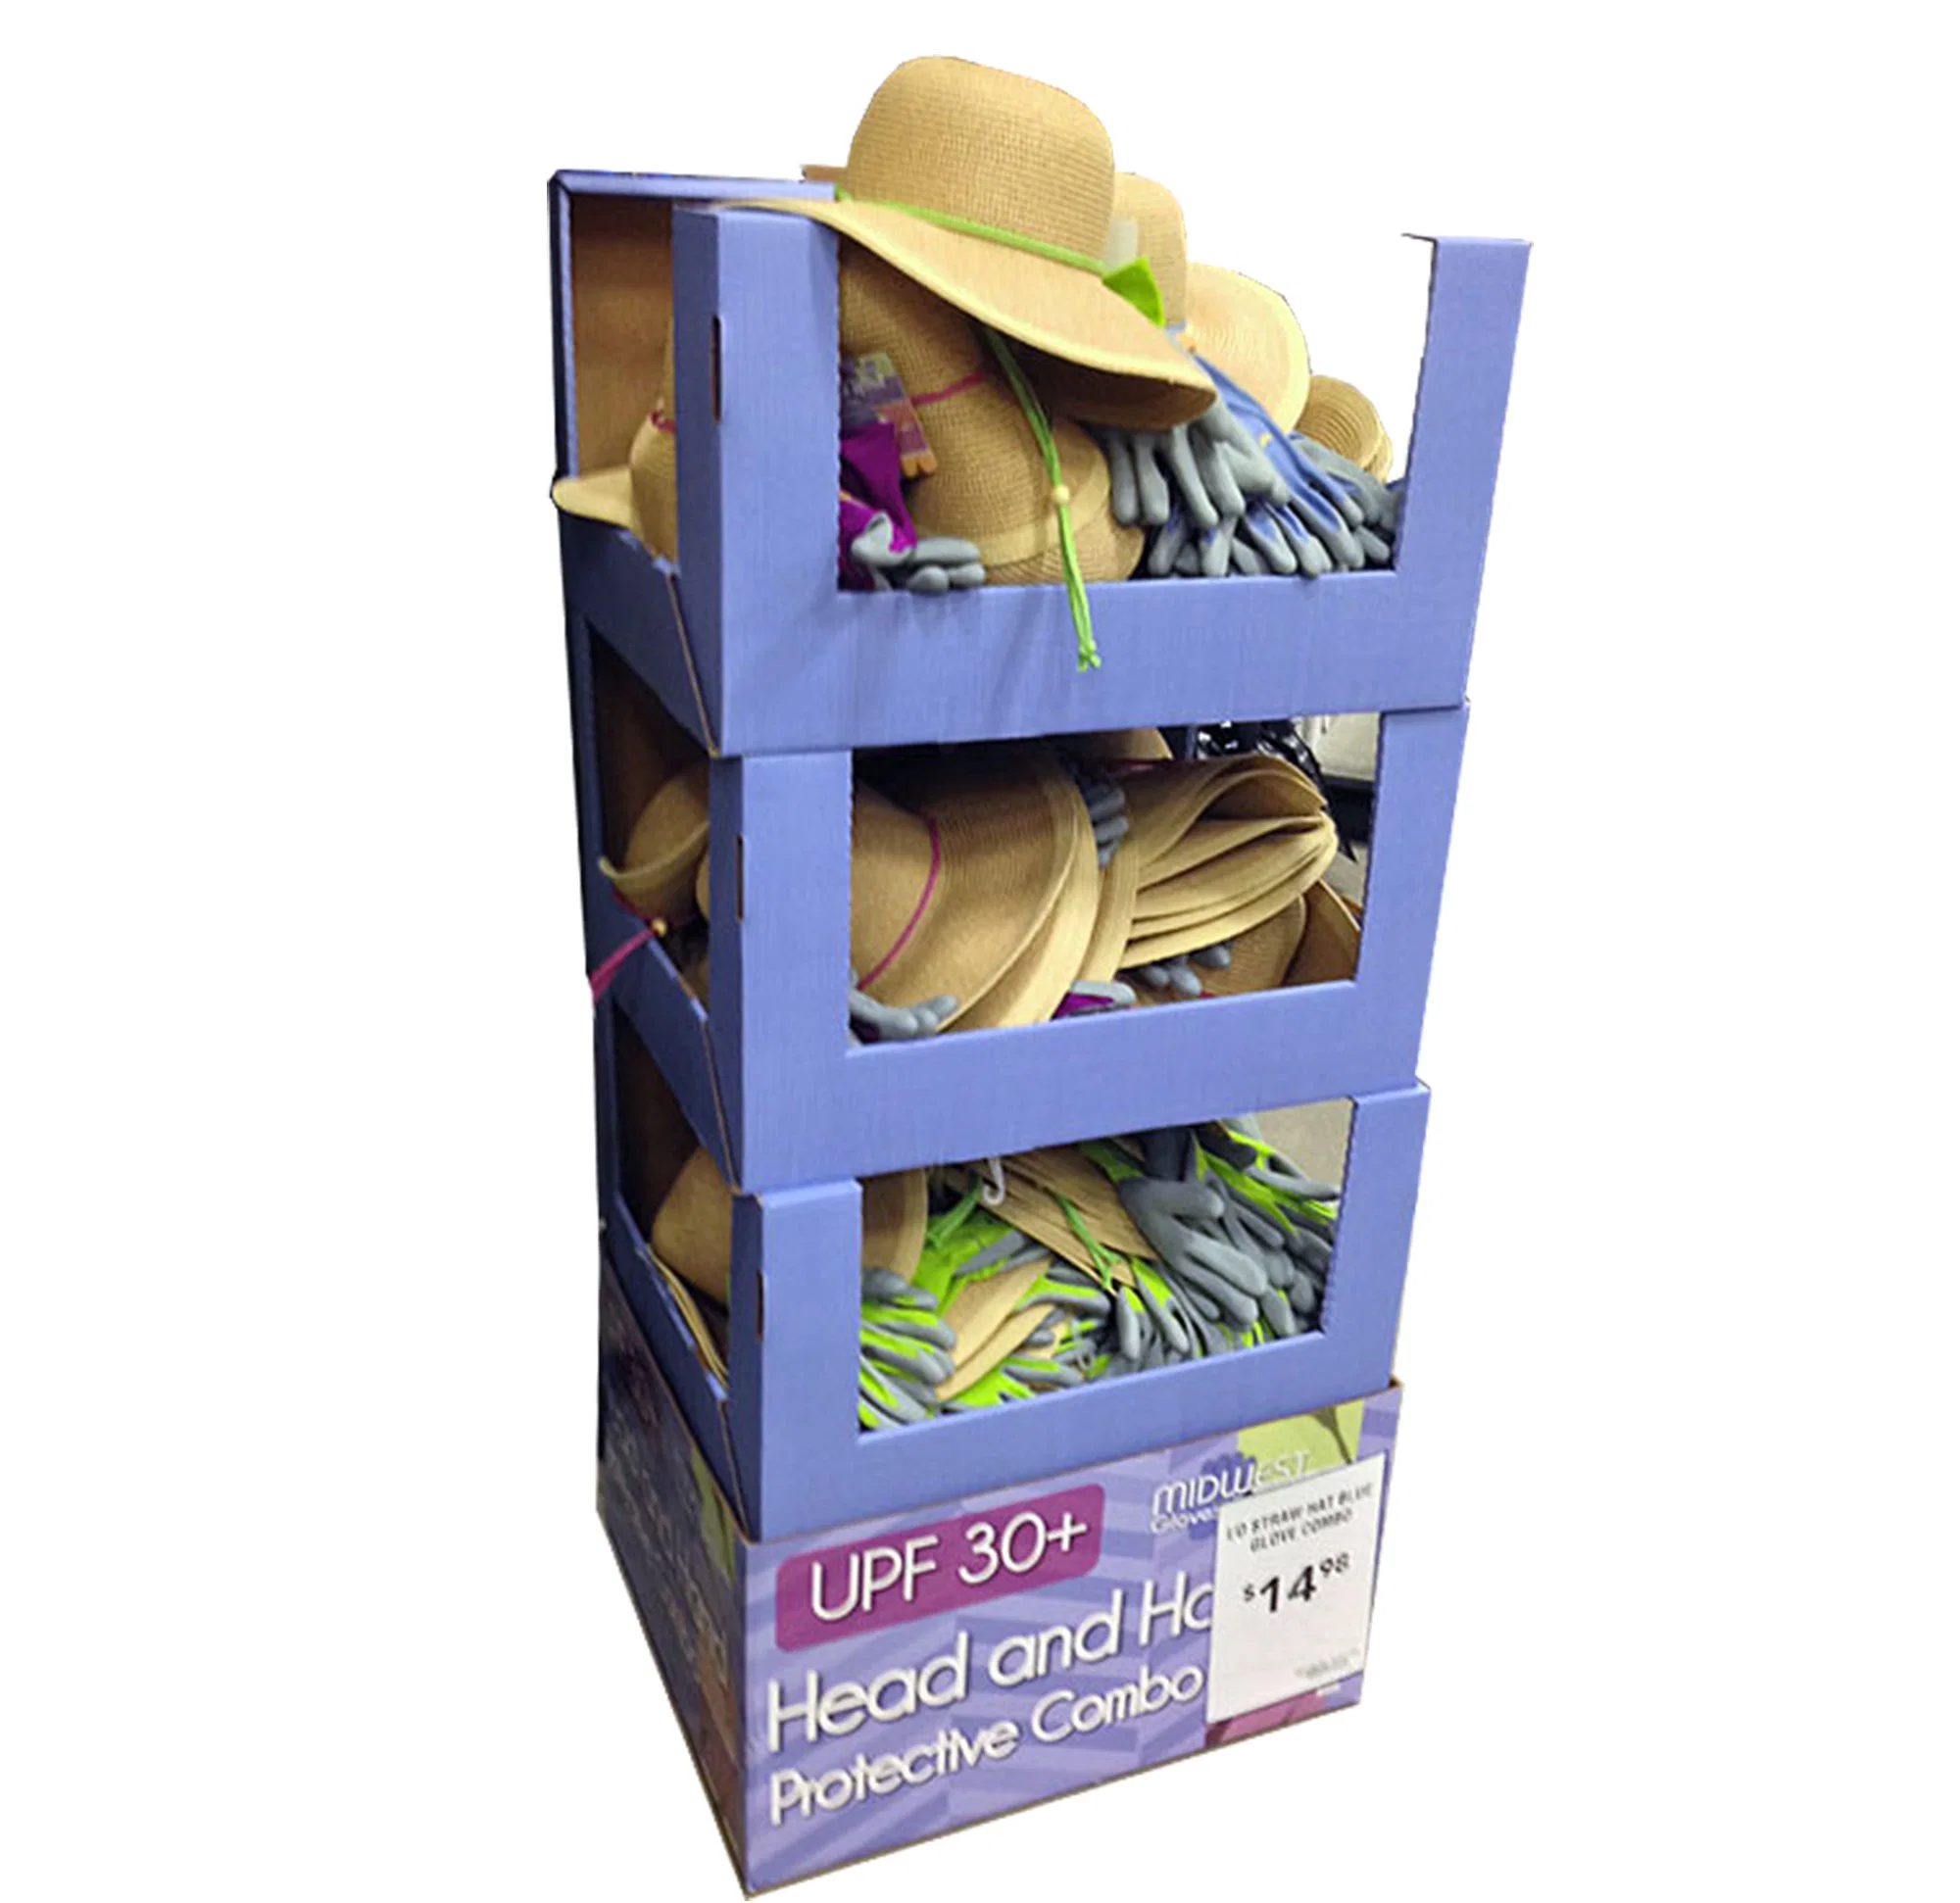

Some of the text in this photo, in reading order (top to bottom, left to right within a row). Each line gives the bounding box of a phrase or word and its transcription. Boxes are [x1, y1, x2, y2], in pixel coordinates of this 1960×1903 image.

[1152, 1449, 1311, 1515] MIDWEST
[1251, 1506, 1303, 1535] STRAW
[1306, 1494, 1334, 1516] HAT
[1338, 1482, 1372, 1506] BLUE
[810, 1512, 1088, 1622] UPF 30+
[1250, 1507, 1352, 1553] GLOVE COMBO
[767, 1631, 968, 1752] Head
[988, 1588, 1122, 1687] and
[768, 1665, 1203, 1827] Protective Combo
